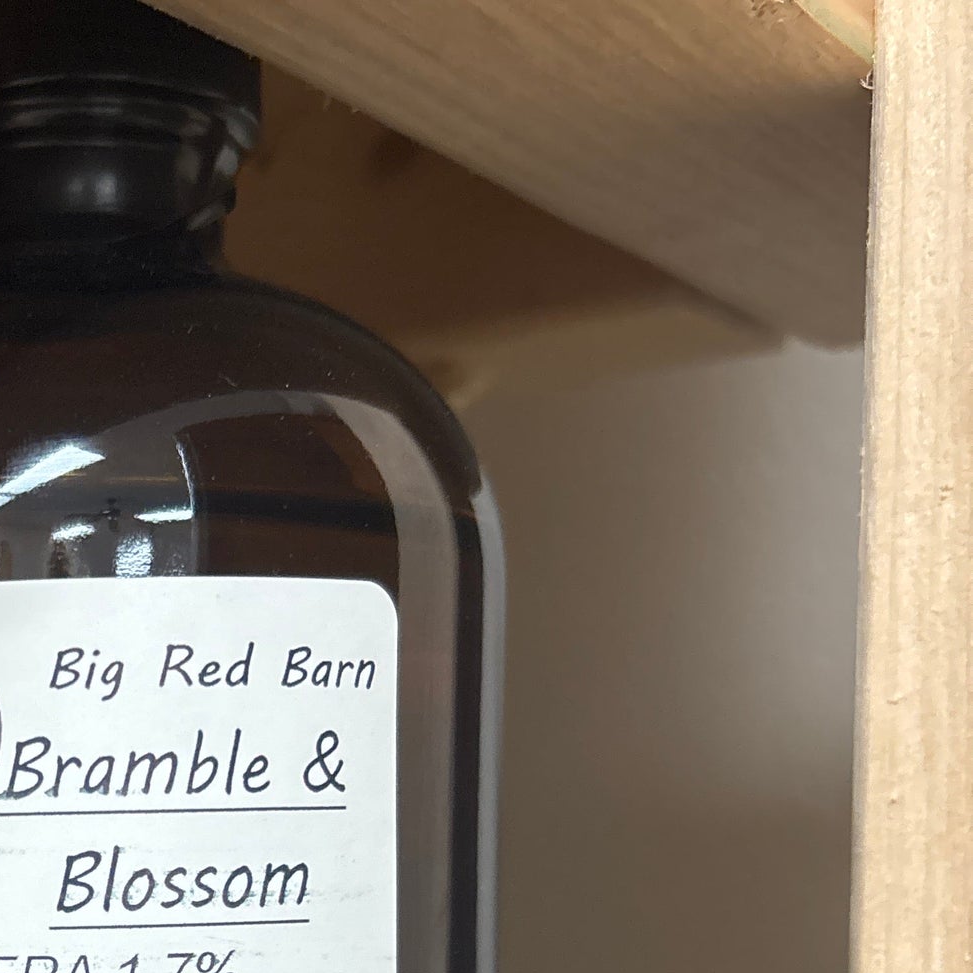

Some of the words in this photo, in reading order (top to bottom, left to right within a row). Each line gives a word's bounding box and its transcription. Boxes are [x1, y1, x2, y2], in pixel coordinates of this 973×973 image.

[49, 644, 125, 701] Big
[159, 642, 255, 690] Red
[281, 645, 376, 690] Barn
[303, 729, 346, 794] &
[57, 845, 311, 914] Blossom
